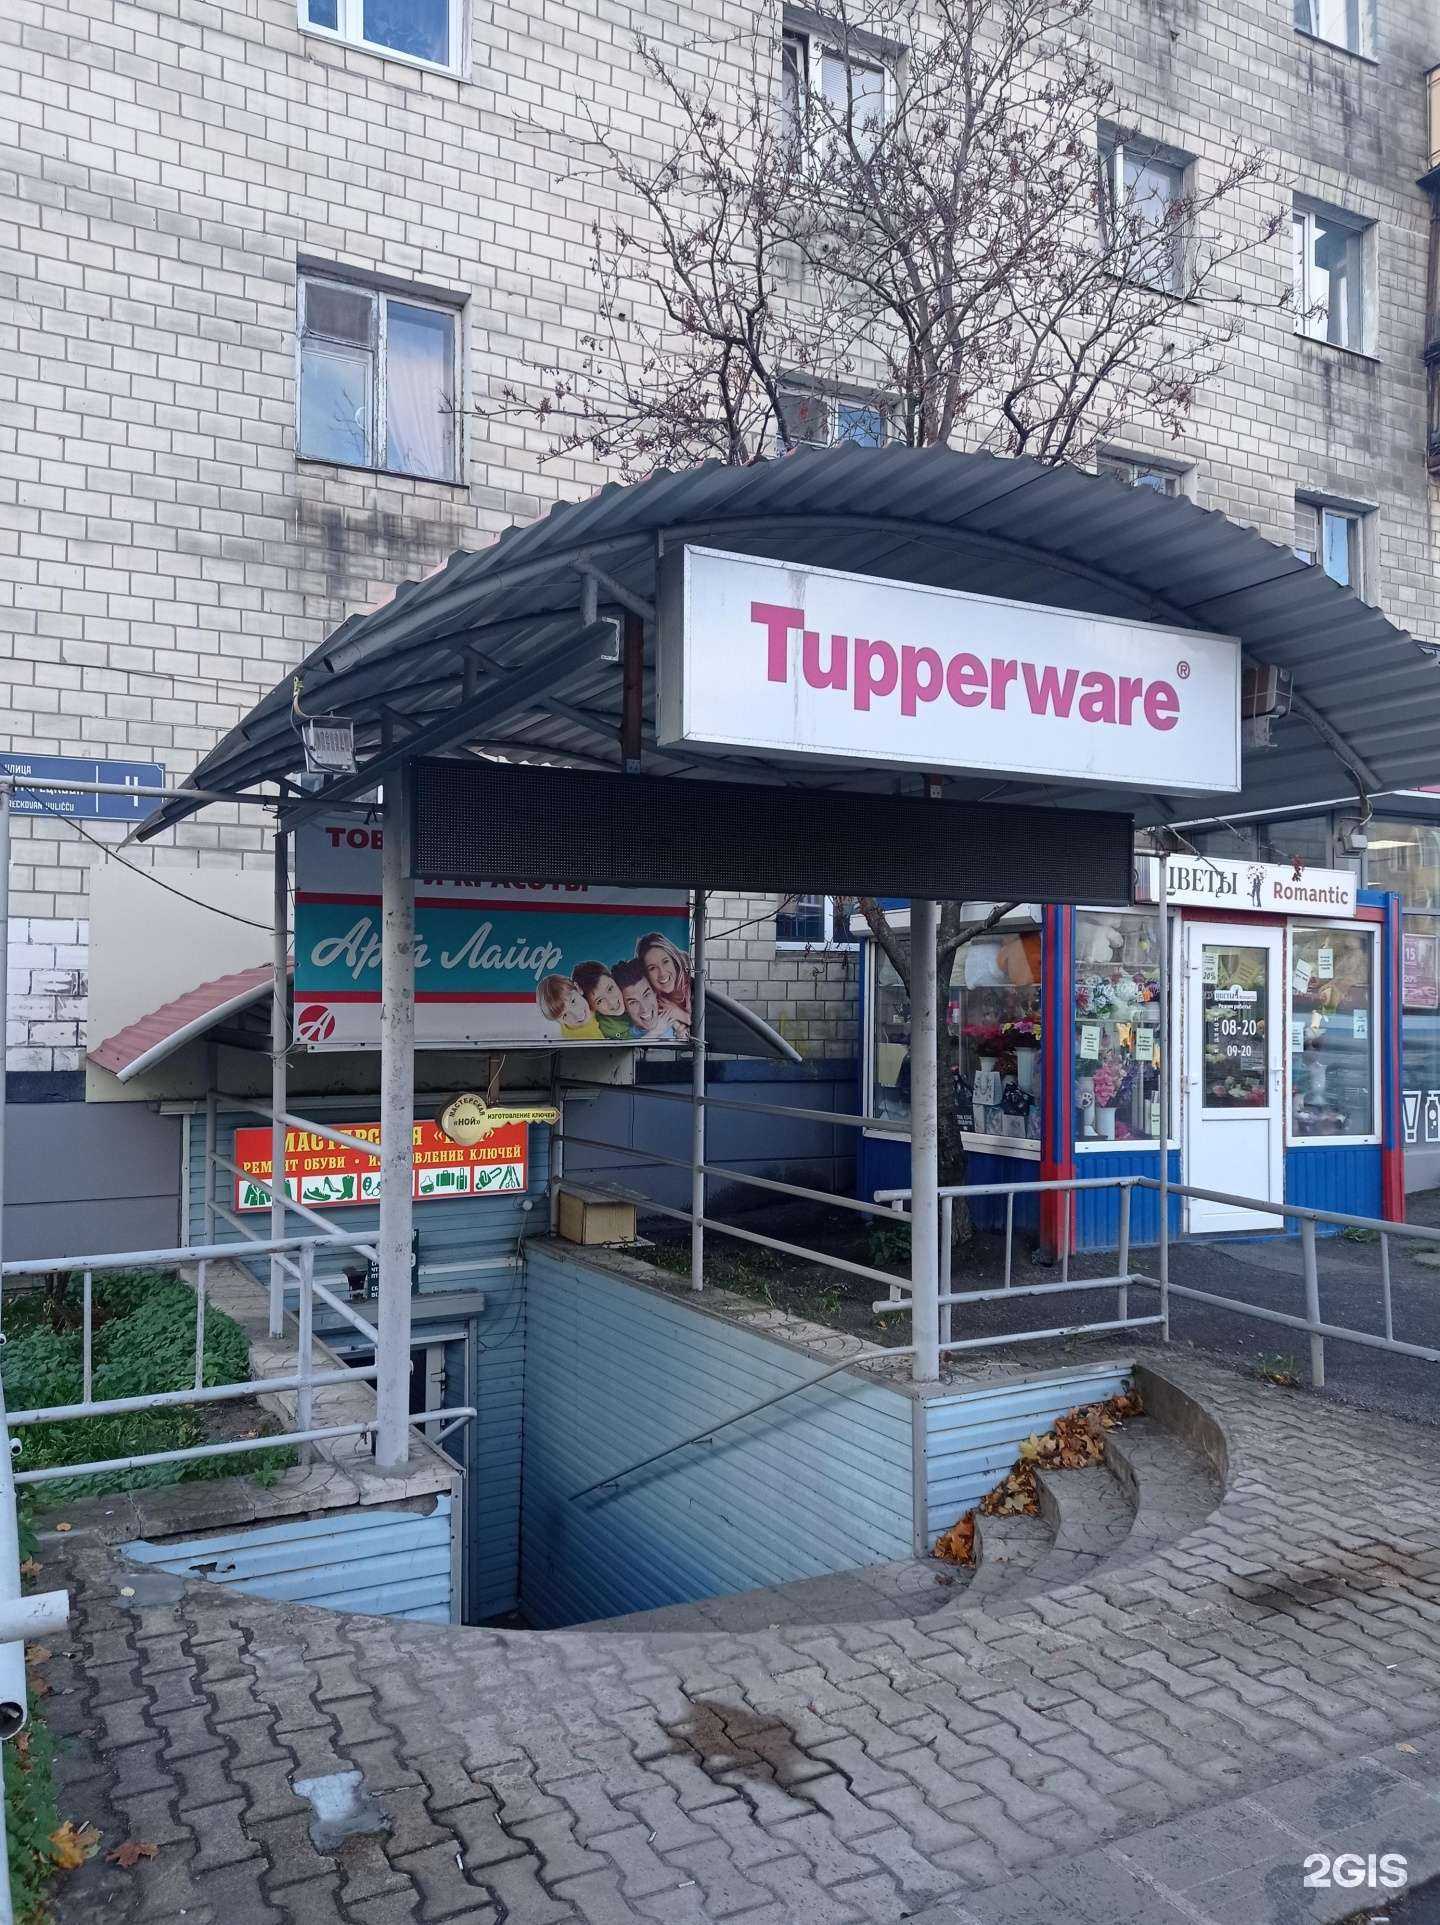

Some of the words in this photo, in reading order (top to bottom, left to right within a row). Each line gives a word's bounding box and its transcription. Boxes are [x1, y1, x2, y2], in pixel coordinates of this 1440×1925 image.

[326, 827, 383, 849] ТОВ
[1273, 881, 1349, 905] Romantic
[1221, 1019, 1257, 1036] 08-20
[1227, 1045, 1252, 1057] 09-20
[449, 1097, 486, 1118] МАСТЕРСКАЯ
[487, 1112, 531, 1120] ИЗГОТОВЛЕНИЕ
[304, 1156, 346, 1171] ОБУВИ
[469, 1145, 521, 1160] КЛЮЧЕЙ
